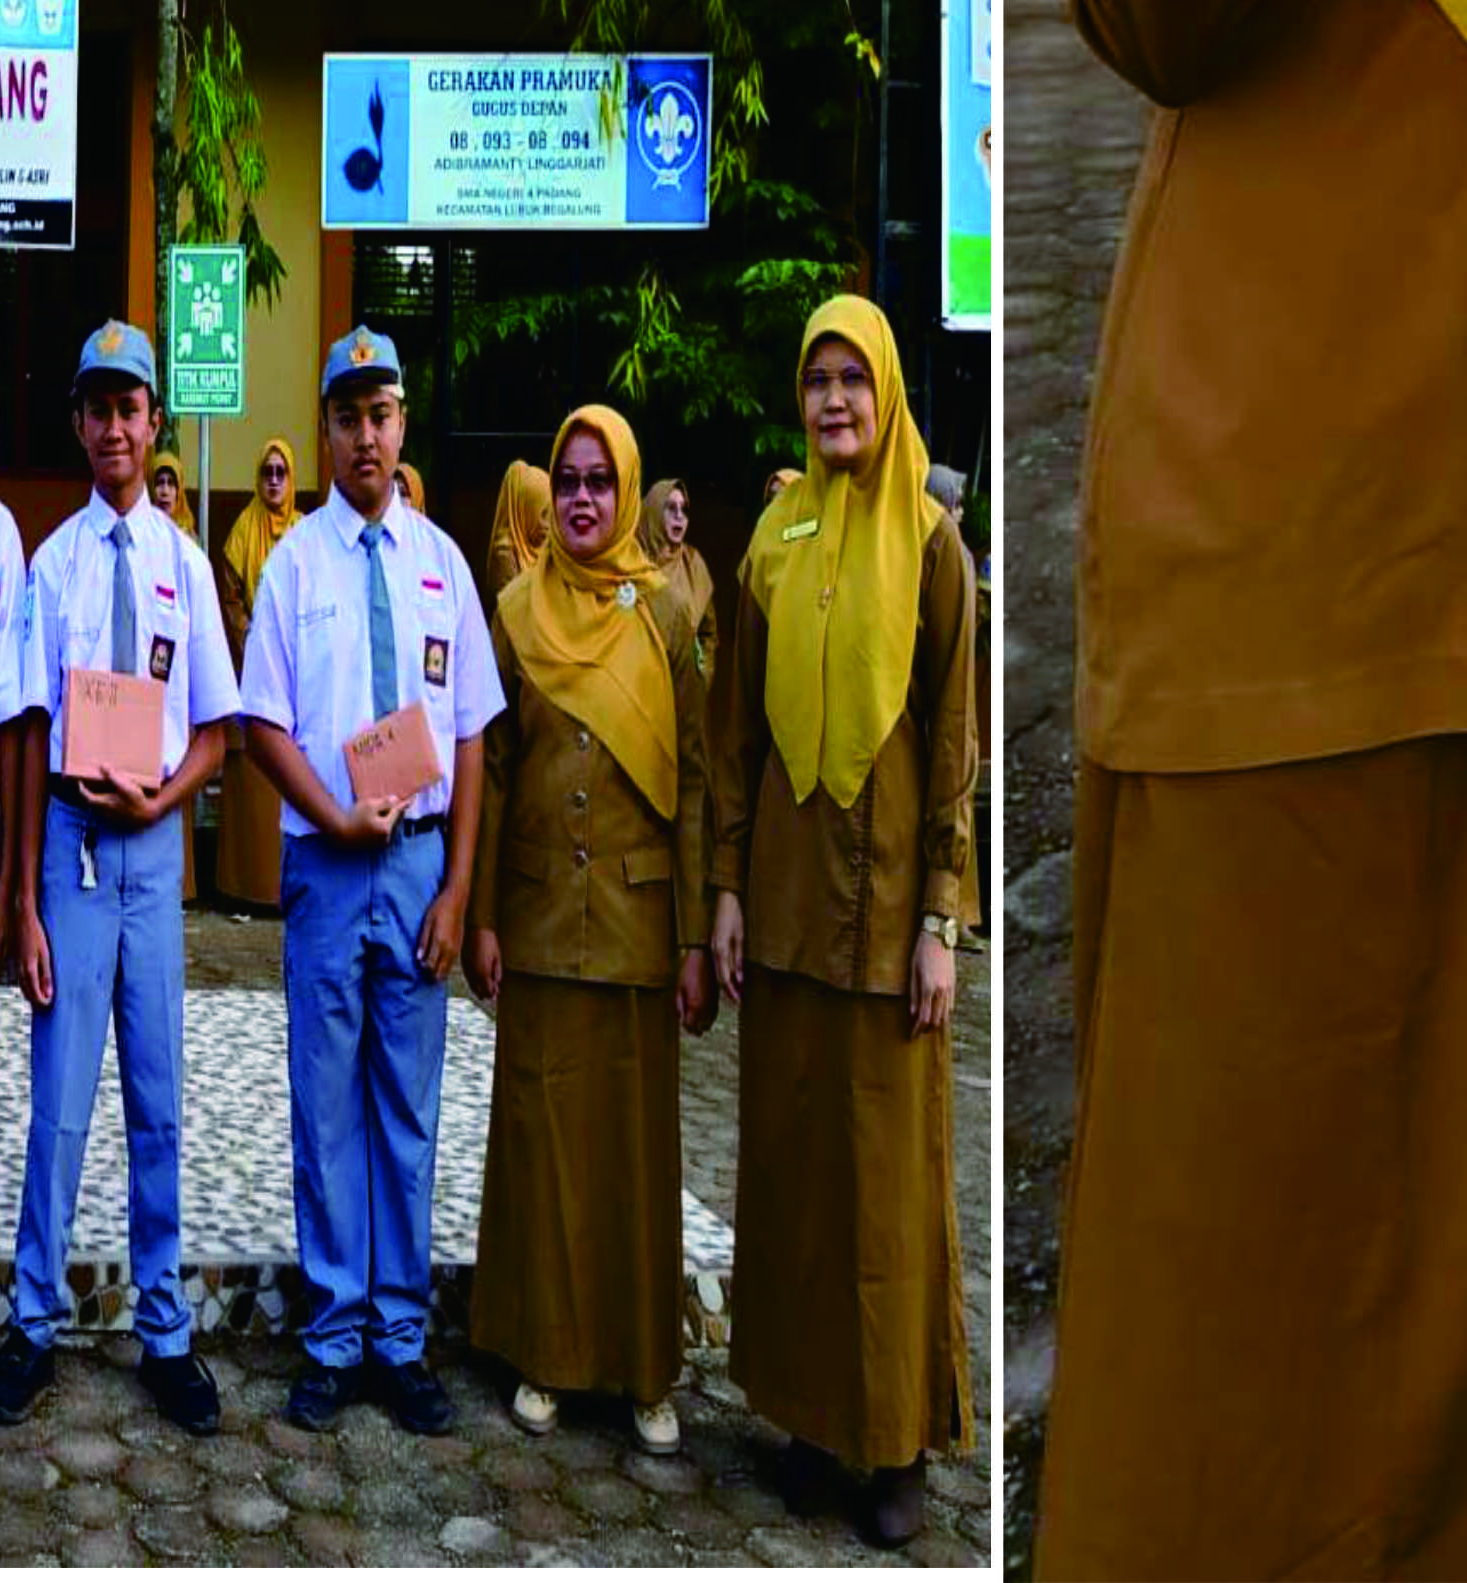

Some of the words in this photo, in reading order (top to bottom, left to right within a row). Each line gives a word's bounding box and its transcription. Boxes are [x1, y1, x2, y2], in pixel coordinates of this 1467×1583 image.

[428, 70, 515, 92] GERAKAN
[521, 70, 613, 92] PRAMUKA
[521, 100, 567, 117] DEPAN
[482, 130, 511, 150] 093
[562, 130, 590, 150] 094
